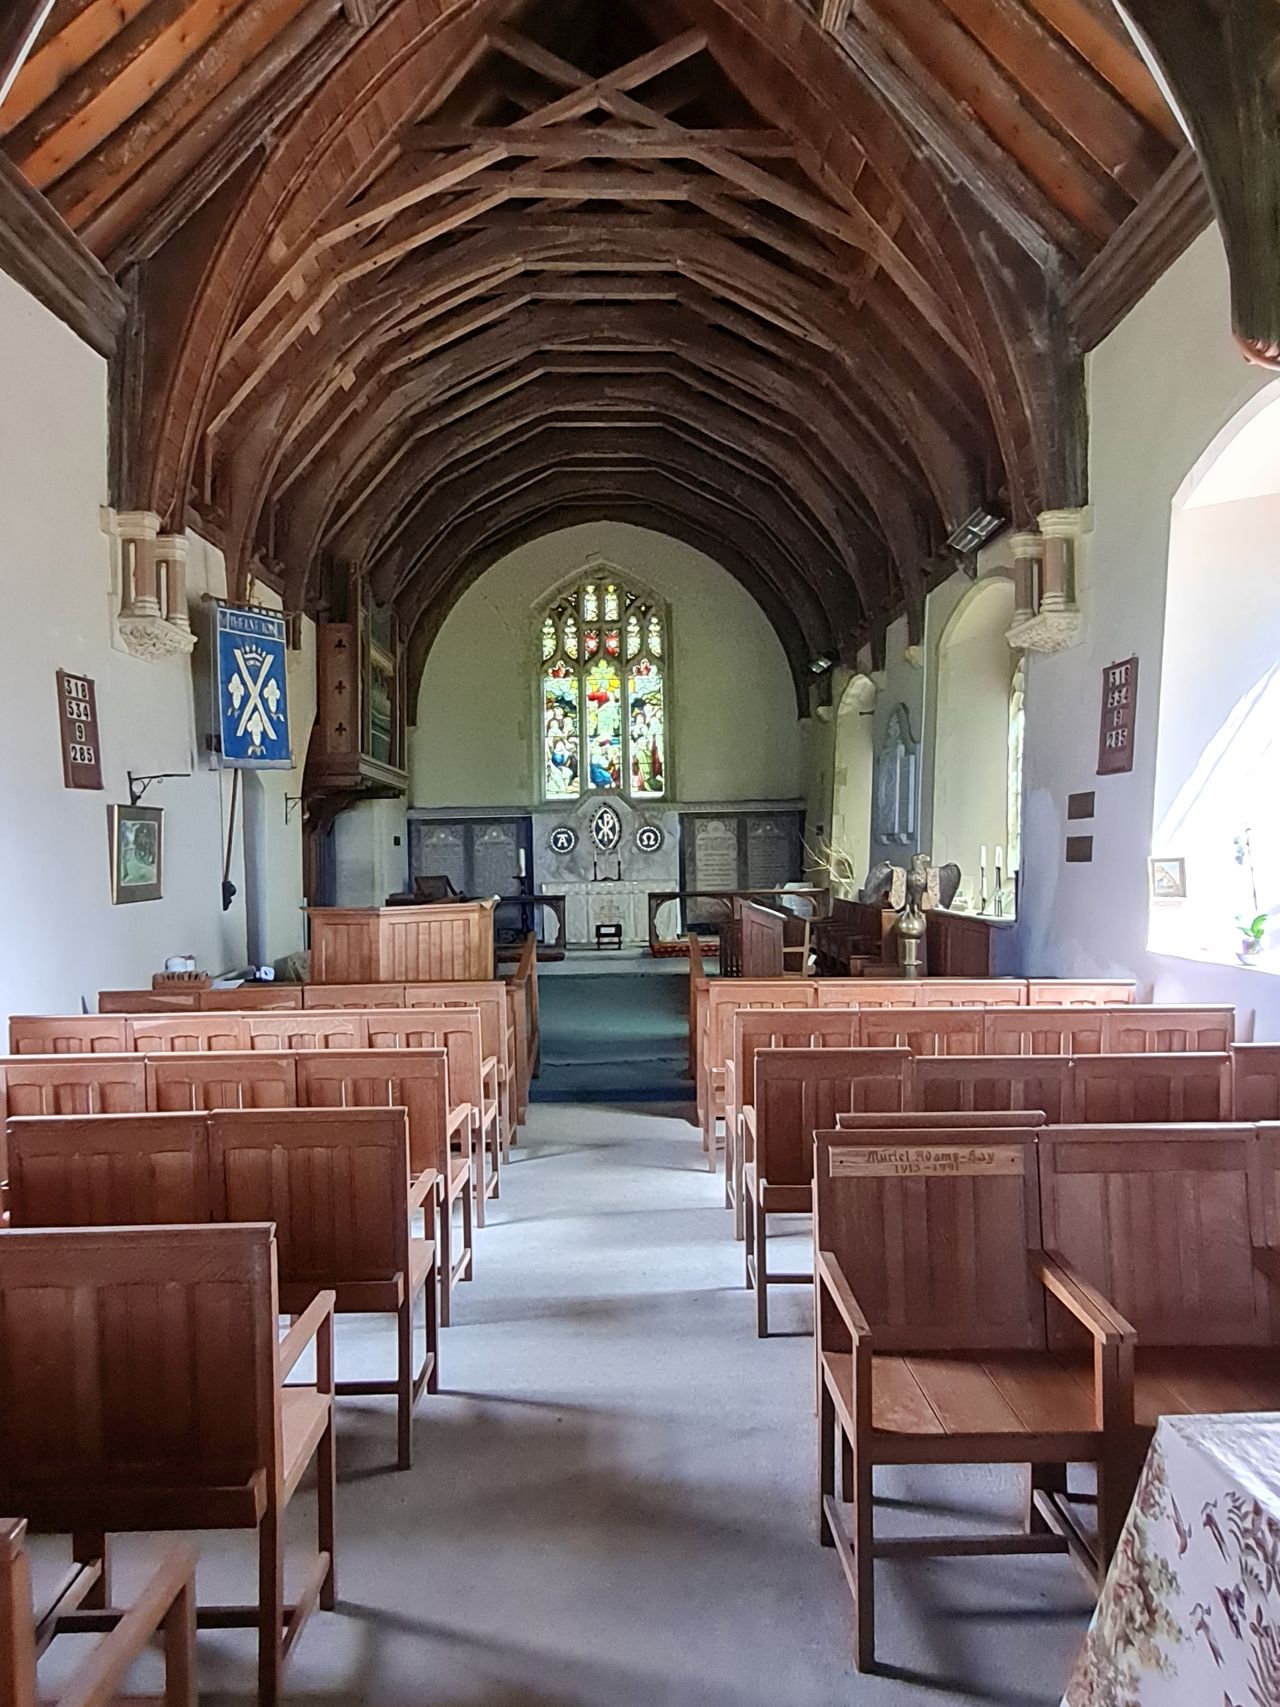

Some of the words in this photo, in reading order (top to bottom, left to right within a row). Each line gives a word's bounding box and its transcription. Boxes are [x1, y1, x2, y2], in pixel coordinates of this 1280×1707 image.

[66, 678, 87, 699] 318
[68, 701, 89, 720] 534
[77, 724, 83, 740] 9
[1108, 729, 1126, 748] 285
[71, 745, 93, 763] 285
[866, 1150, 910, 1163] Muriel
